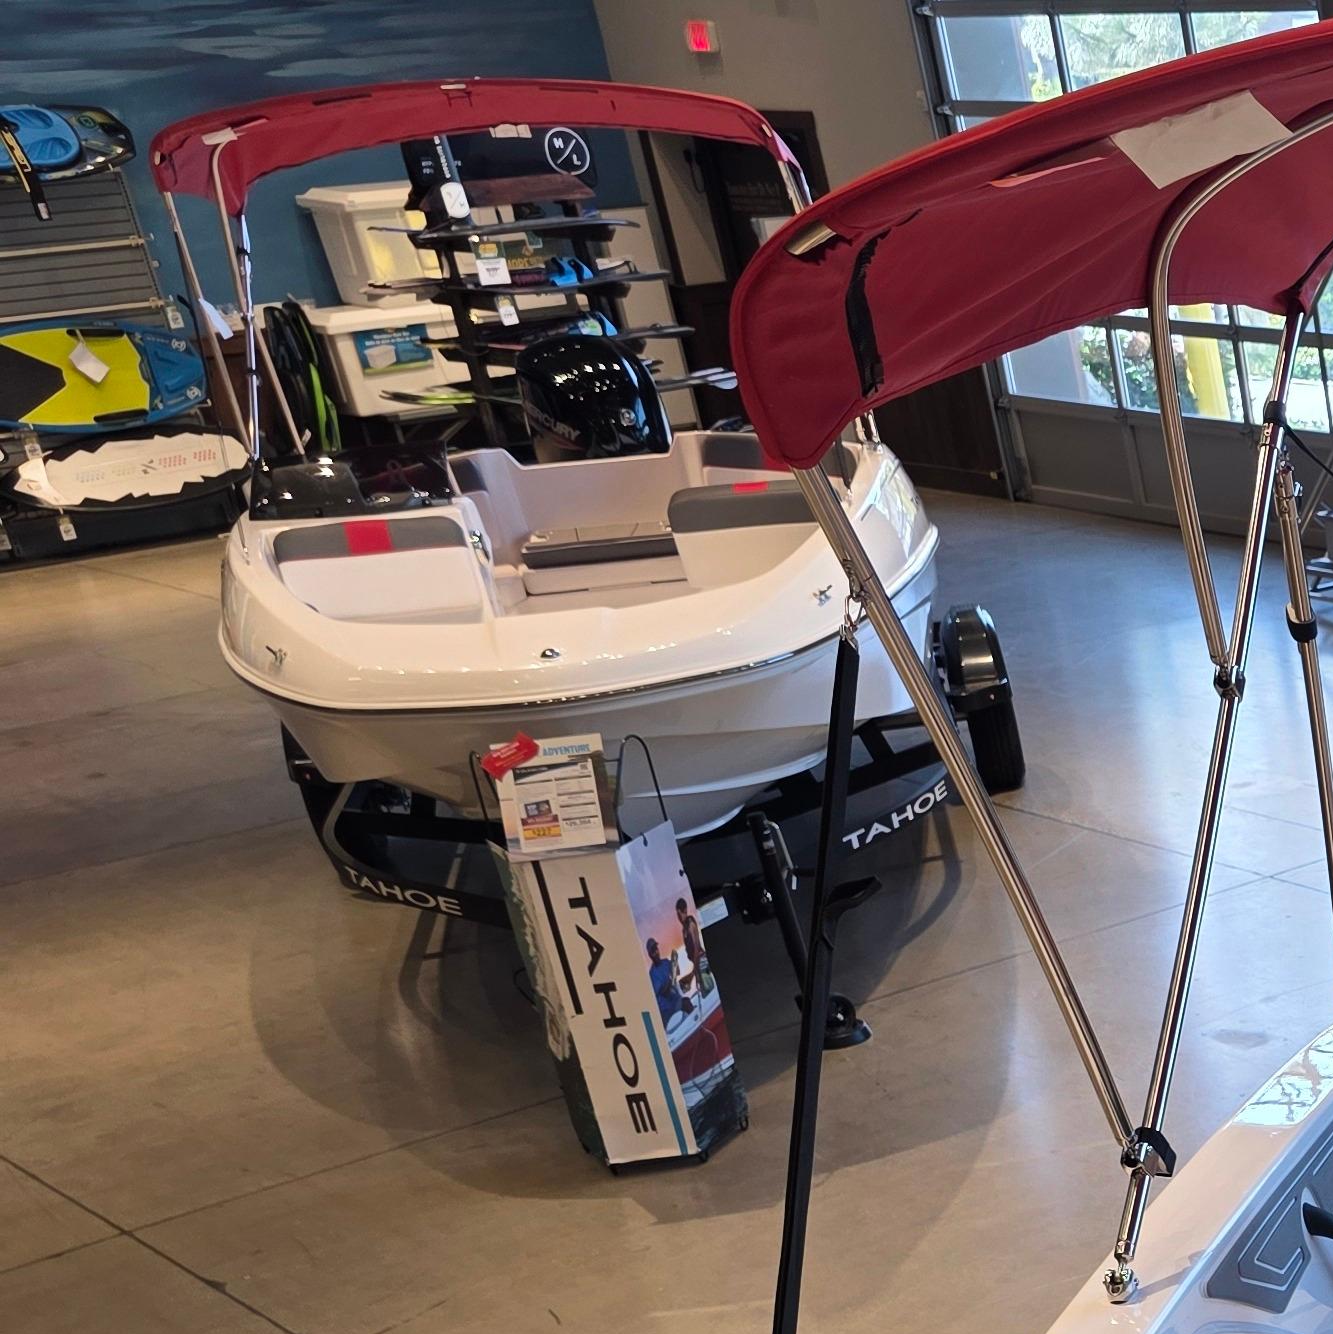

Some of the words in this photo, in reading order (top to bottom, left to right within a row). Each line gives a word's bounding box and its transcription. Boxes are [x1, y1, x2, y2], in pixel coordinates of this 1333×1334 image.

[842, 780, 948, 849] TAHOE
[345, 866, 463, 916] TAHOE
[568, 877, 659, 1134] TAHOE
